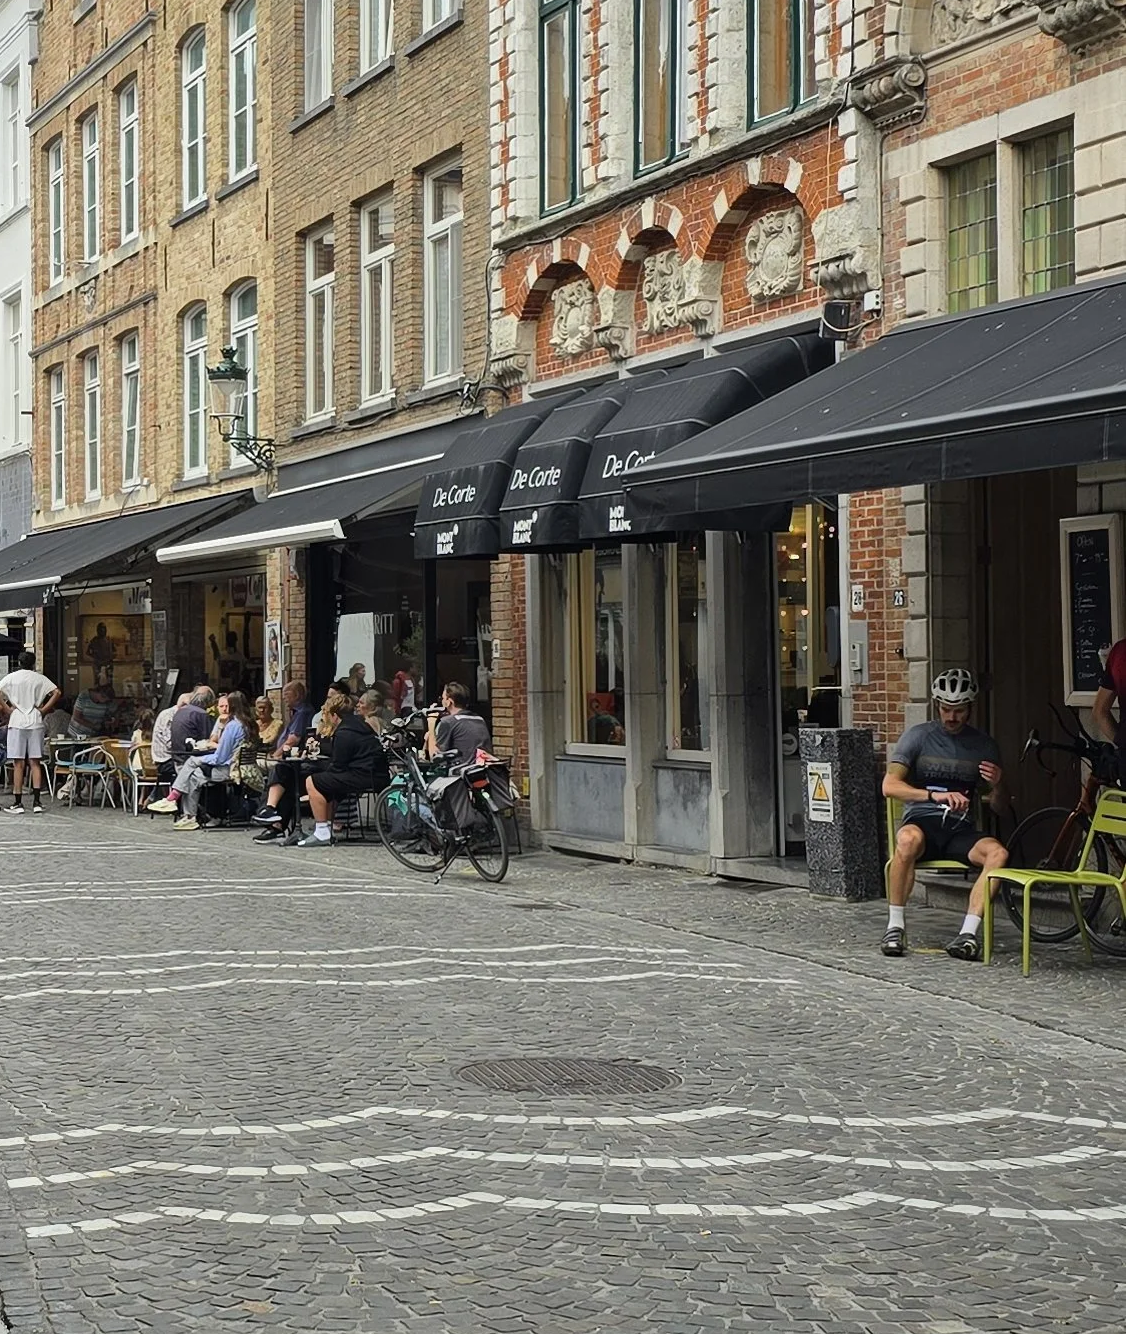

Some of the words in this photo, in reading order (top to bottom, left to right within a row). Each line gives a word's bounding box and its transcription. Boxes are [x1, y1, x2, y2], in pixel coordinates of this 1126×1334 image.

[603, 455, 622, 479] De
[510, 469, 527, 490] De
[528, 466, 561, 488] Corte
[433, 487, 447, 507] De
[447, 484, 476, 505] Corte
[513, 519, 532, 533] MONT
[437, 531, 453, 544] MONT
[512, 531, 532, 544] BLANC
[436, 543, 454, 555] BLANC
[894, 591, 903, 606] 26
